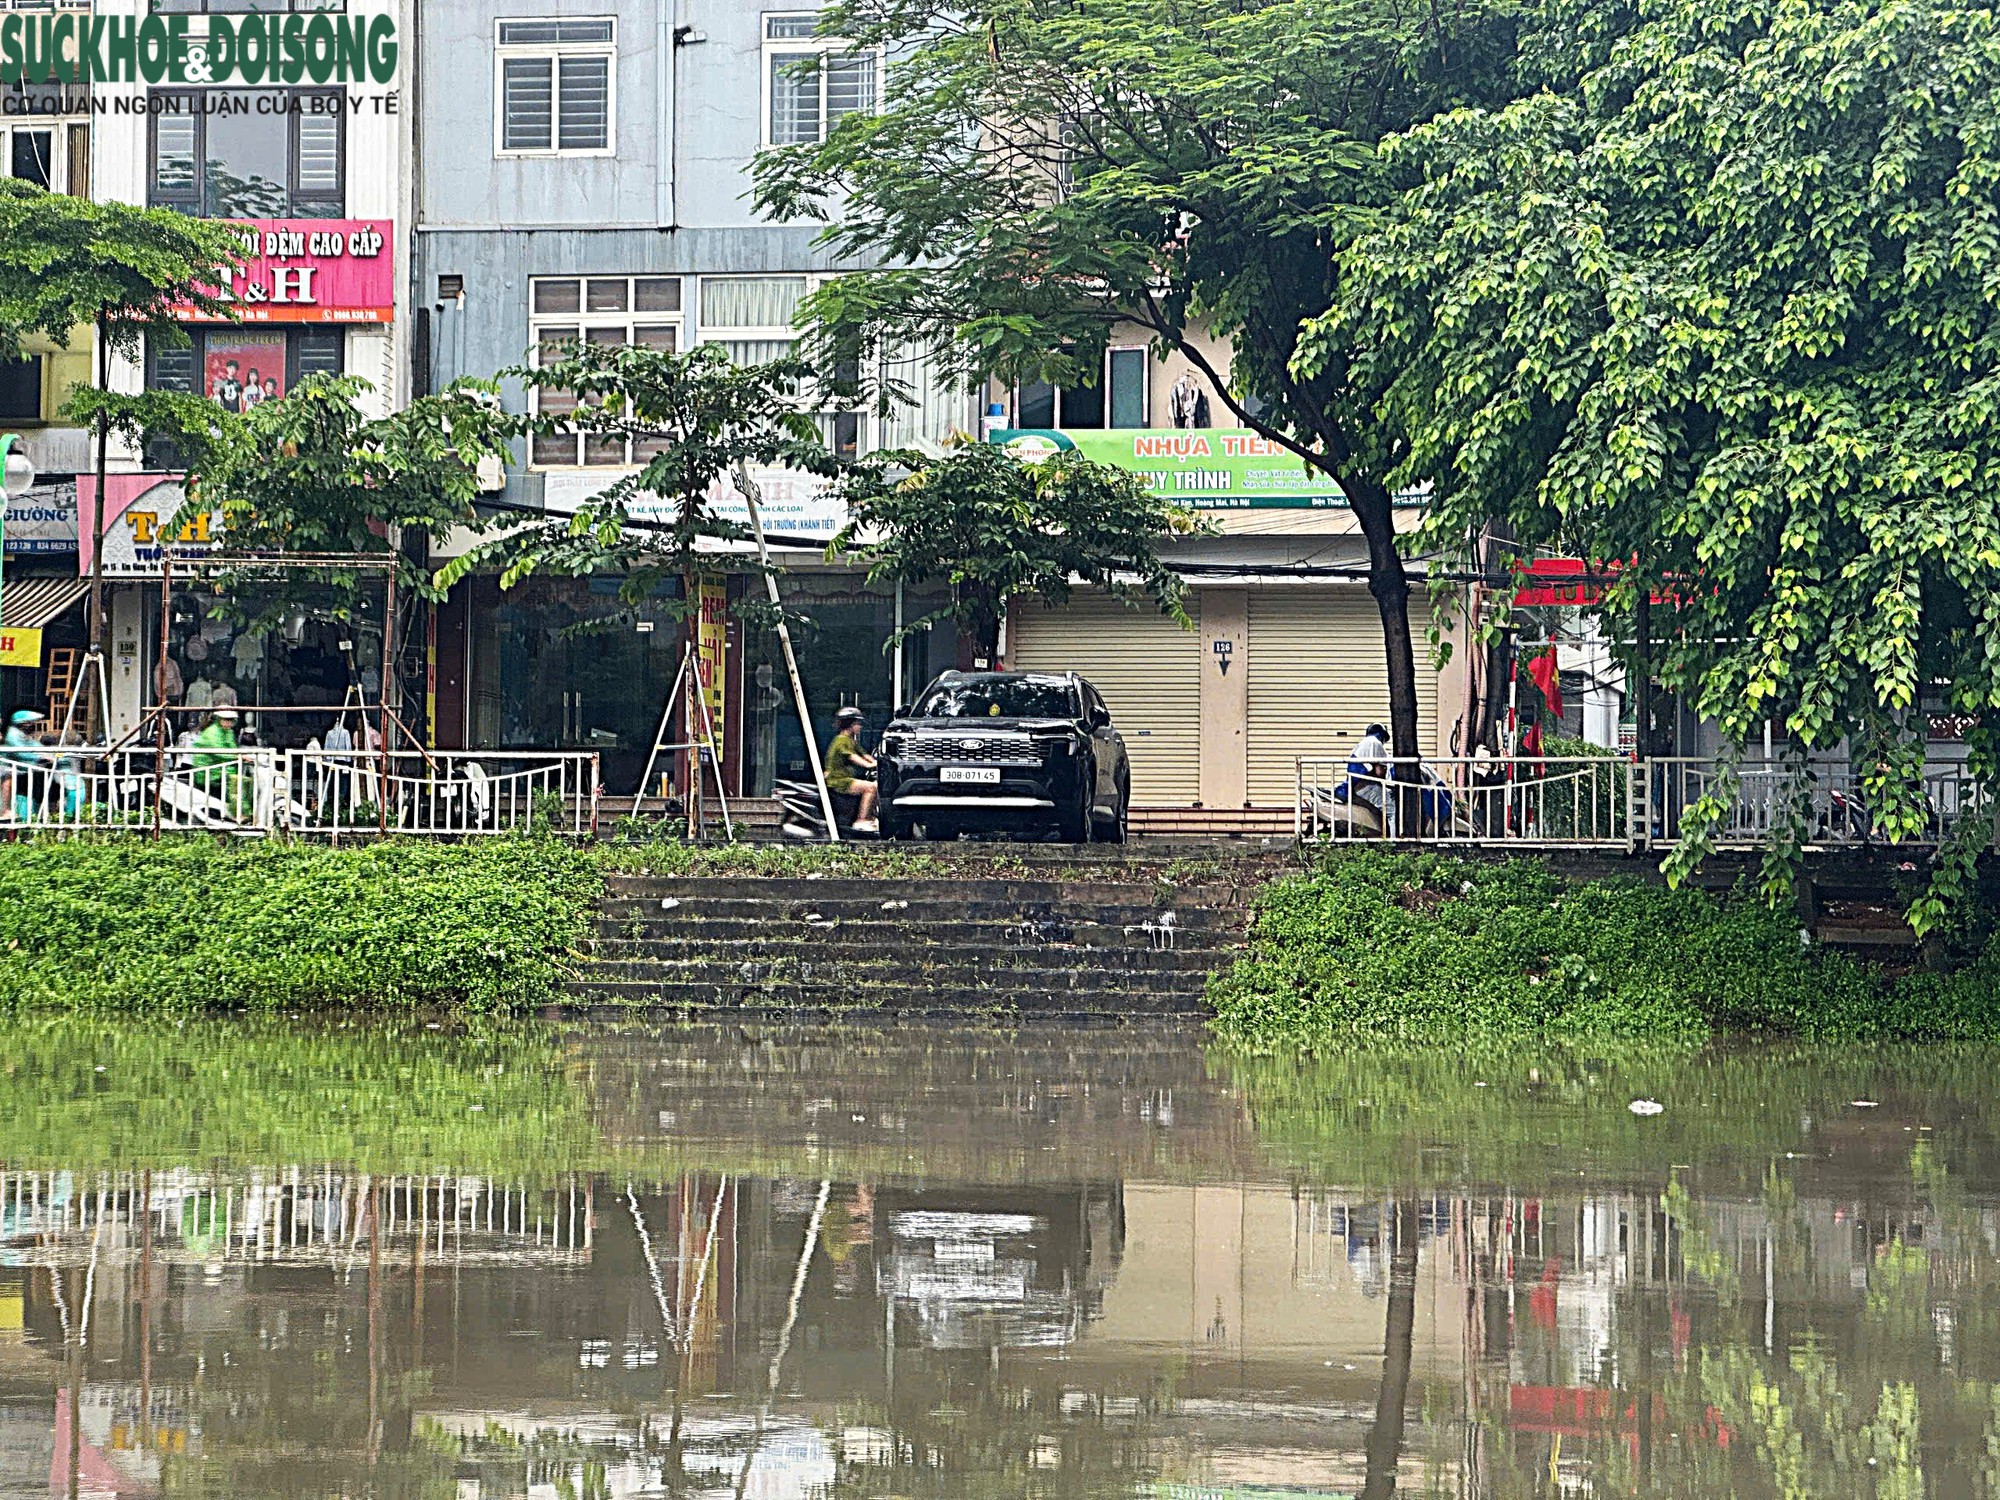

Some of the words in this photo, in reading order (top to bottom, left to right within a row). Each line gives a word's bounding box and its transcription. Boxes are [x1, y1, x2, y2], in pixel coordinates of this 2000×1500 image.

[266, 227, 304, 262] ĐỆM
[308, 232, 343, 256] CAO
[348, 224, 383, 256] CẤP
[1135, 434, 1209, 461] NHỰA
[1173, 467, 1231, 490] TRÌNH
